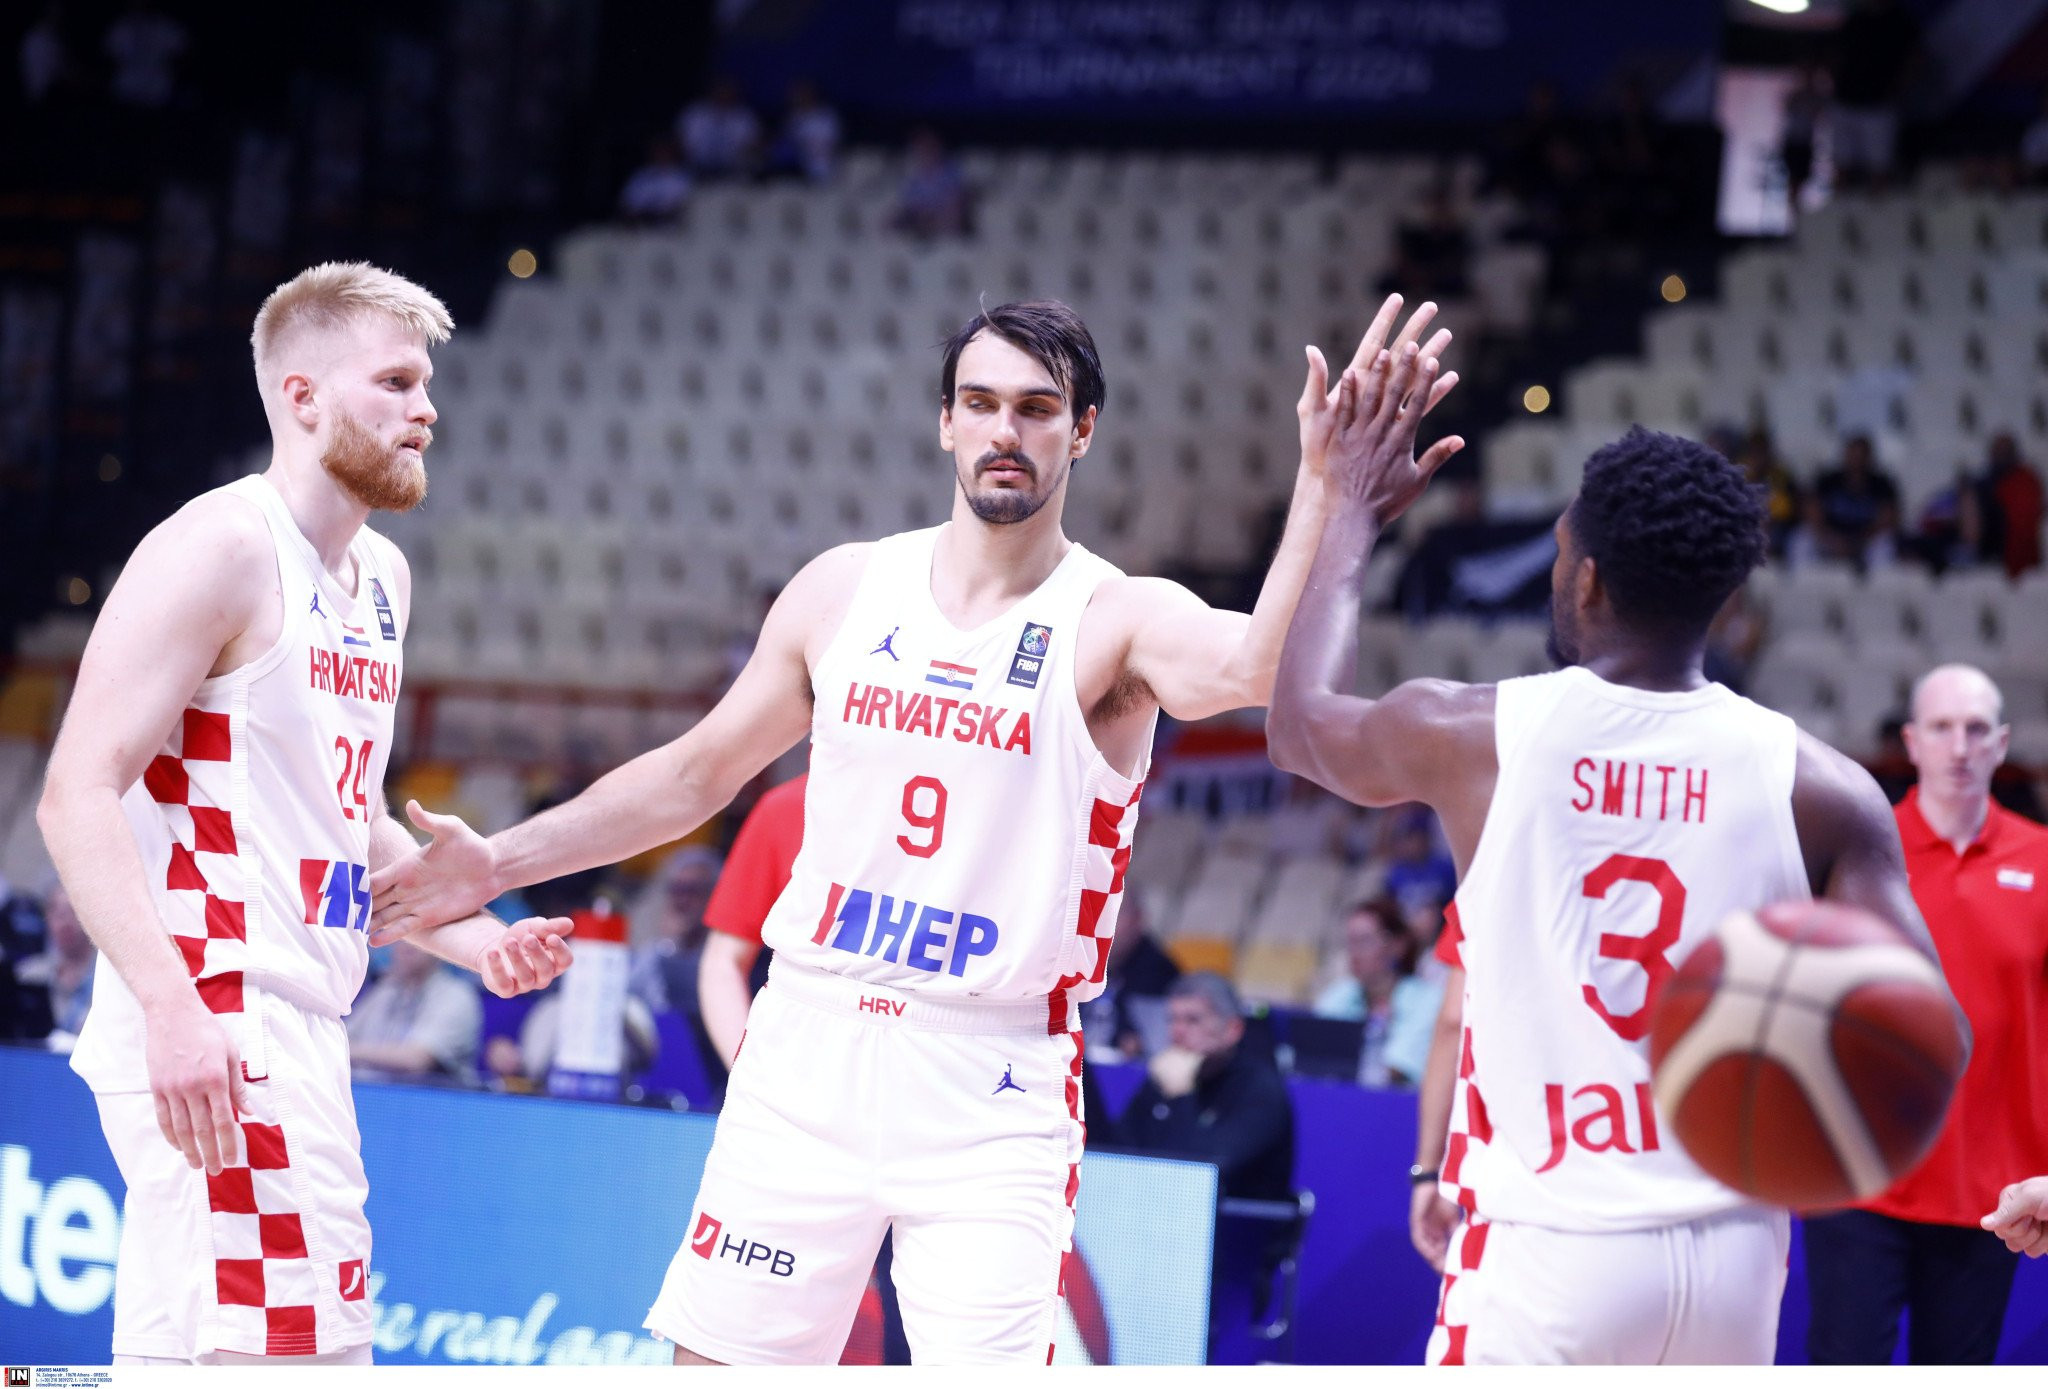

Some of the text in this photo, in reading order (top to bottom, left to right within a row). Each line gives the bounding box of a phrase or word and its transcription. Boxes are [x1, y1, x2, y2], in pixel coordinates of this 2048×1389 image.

[1016, 658, 1040, 673] FIBA
[843, 682, 1032, 756] HRVATSKA
[335, 735, 374, 823] 24
[1572, 757, 1708, 824] SMITH
[896, 774, 949, 859] 9
[1582, 853, 1687, 1042] 3
[859, 995, 907, 1017] HRV
[720, 1233, 796, 1277] HPB
